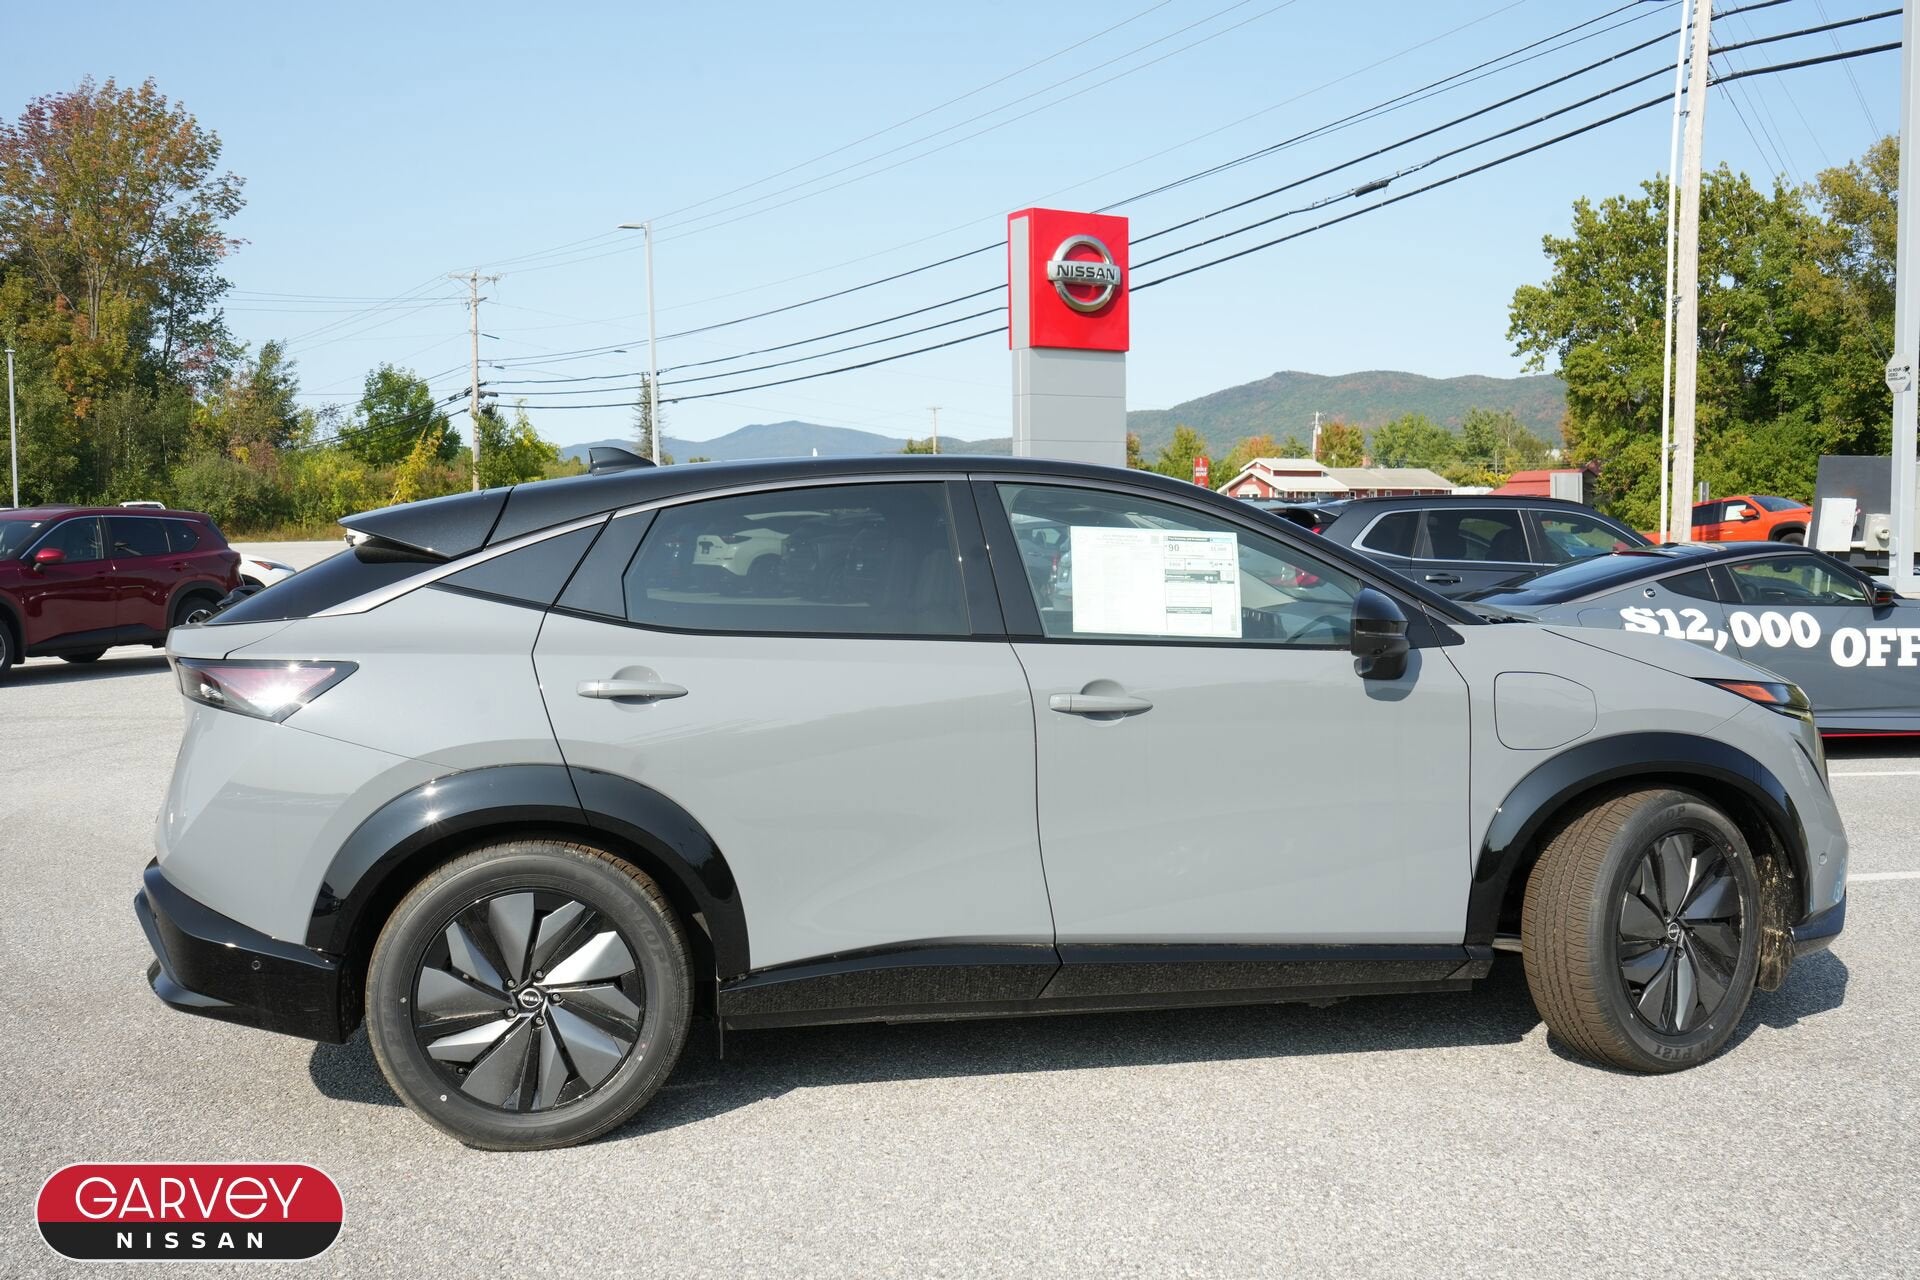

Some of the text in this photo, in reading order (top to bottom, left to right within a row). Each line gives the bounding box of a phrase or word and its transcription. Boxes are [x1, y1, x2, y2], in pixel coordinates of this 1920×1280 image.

[1057, 264, 1115, 280] NISSAN
[1168, 544, 1180, 552] 90
[1620, 606, 1821, 651] $12,000
